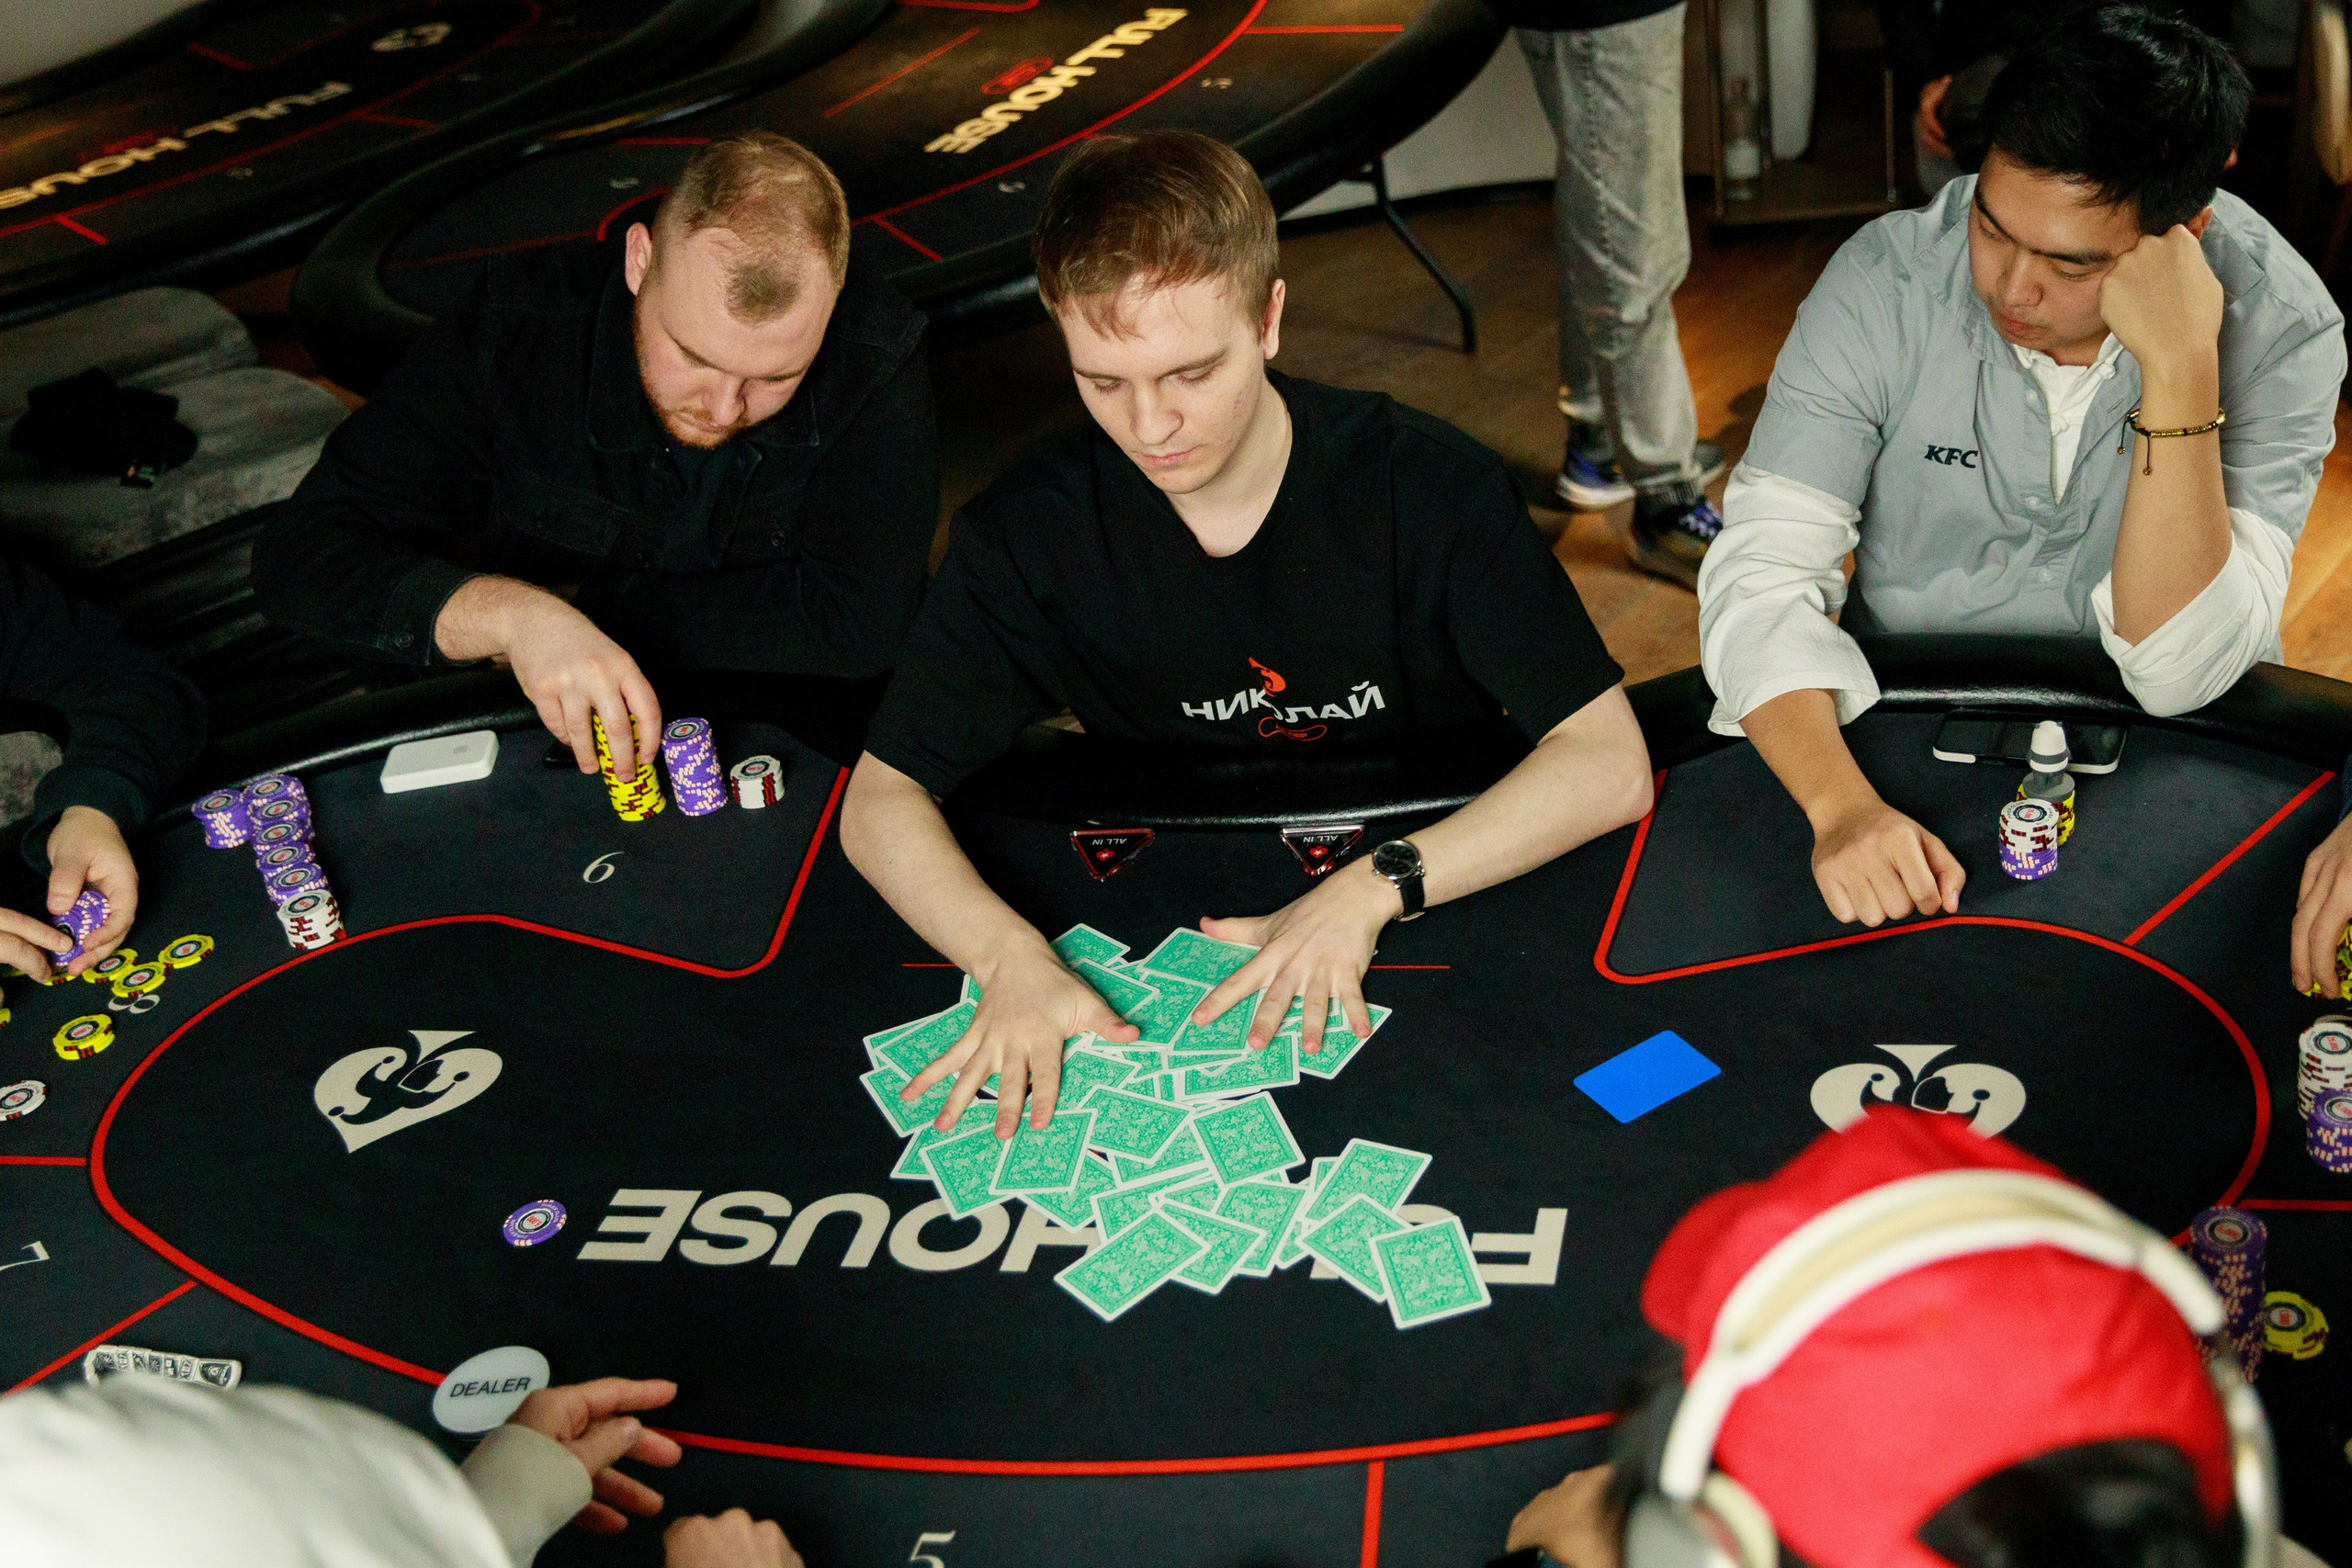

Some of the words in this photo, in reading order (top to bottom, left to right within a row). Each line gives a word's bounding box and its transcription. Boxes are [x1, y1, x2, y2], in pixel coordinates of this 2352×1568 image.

[1065, 7, 1188, 65] FULL
[922, 65, 1097, 153] HOUSE
[1924, 445, 1978, 468] KFC
[1317, 834, 1339, 842] ALL
[449, 1377, 531, 1397] DEALER
